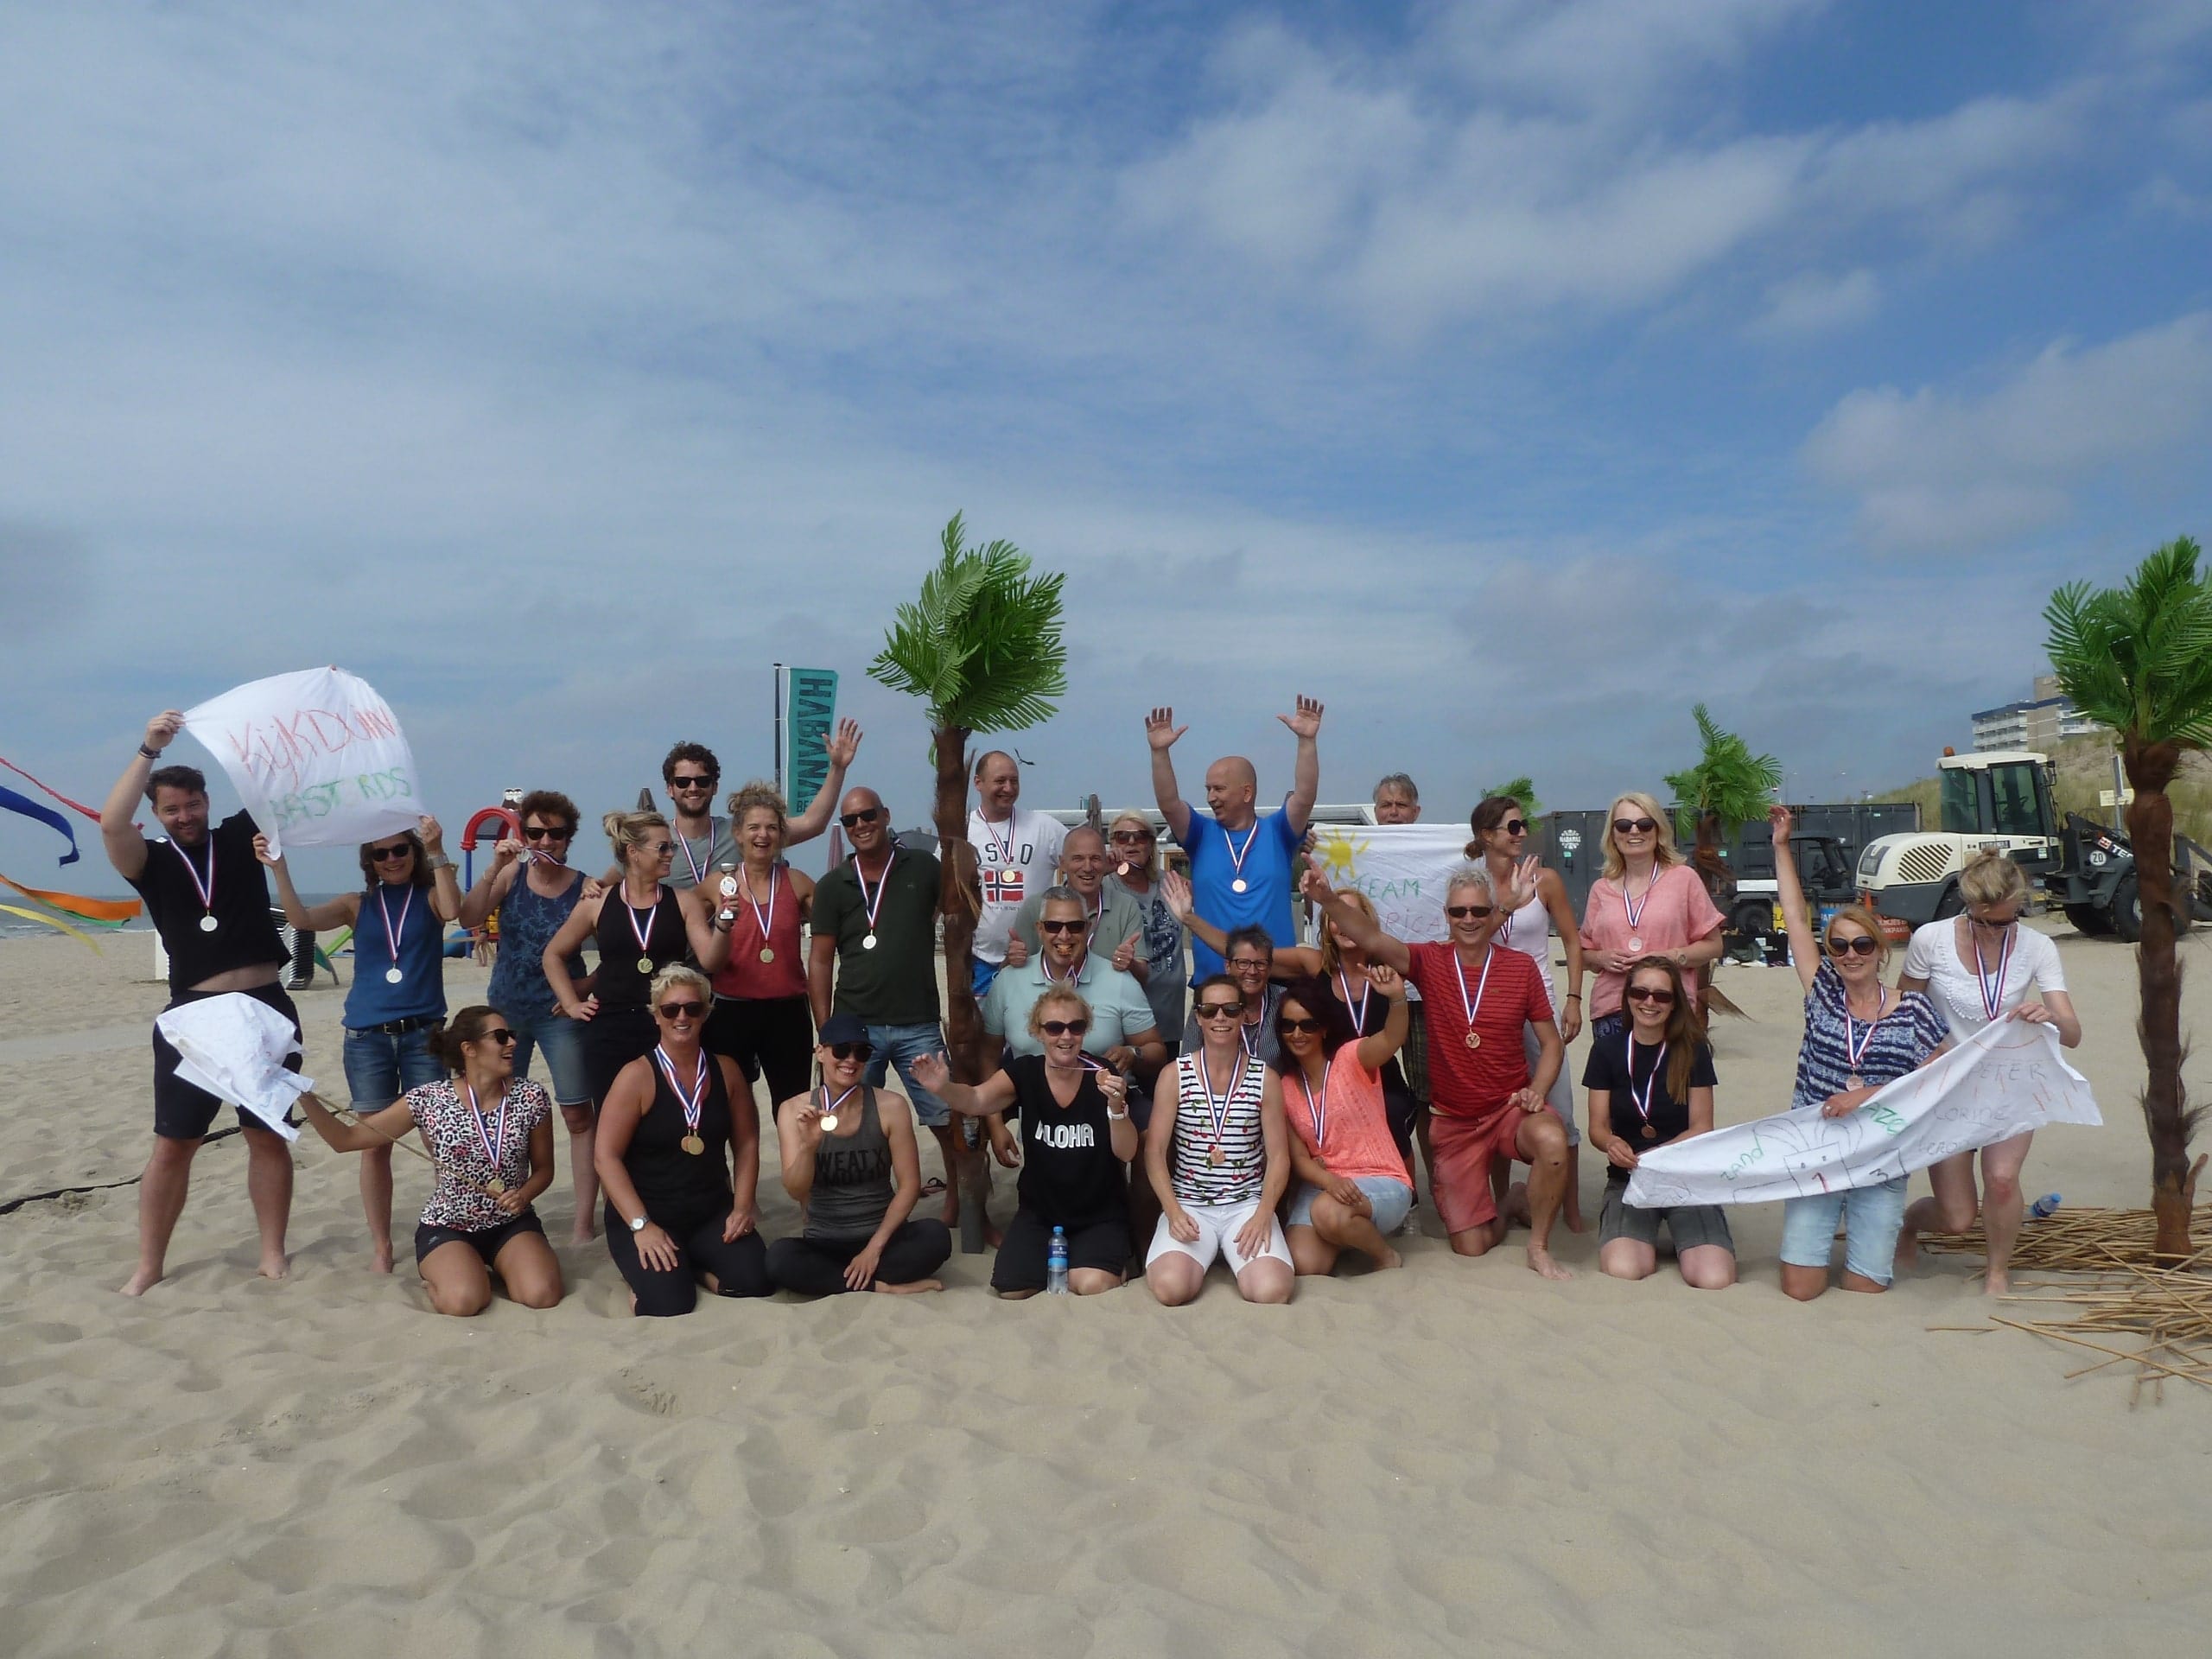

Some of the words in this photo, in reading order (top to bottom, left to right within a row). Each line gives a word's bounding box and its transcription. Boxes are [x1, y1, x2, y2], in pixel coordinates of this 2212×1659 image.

[2093, 853, 2103, 862] 20
[1350, 872, 1421, 899] TEAM
[1967, 1060, 2047, 1081] PETER
[1034, 1119, 1095, 1149] ALOHA
